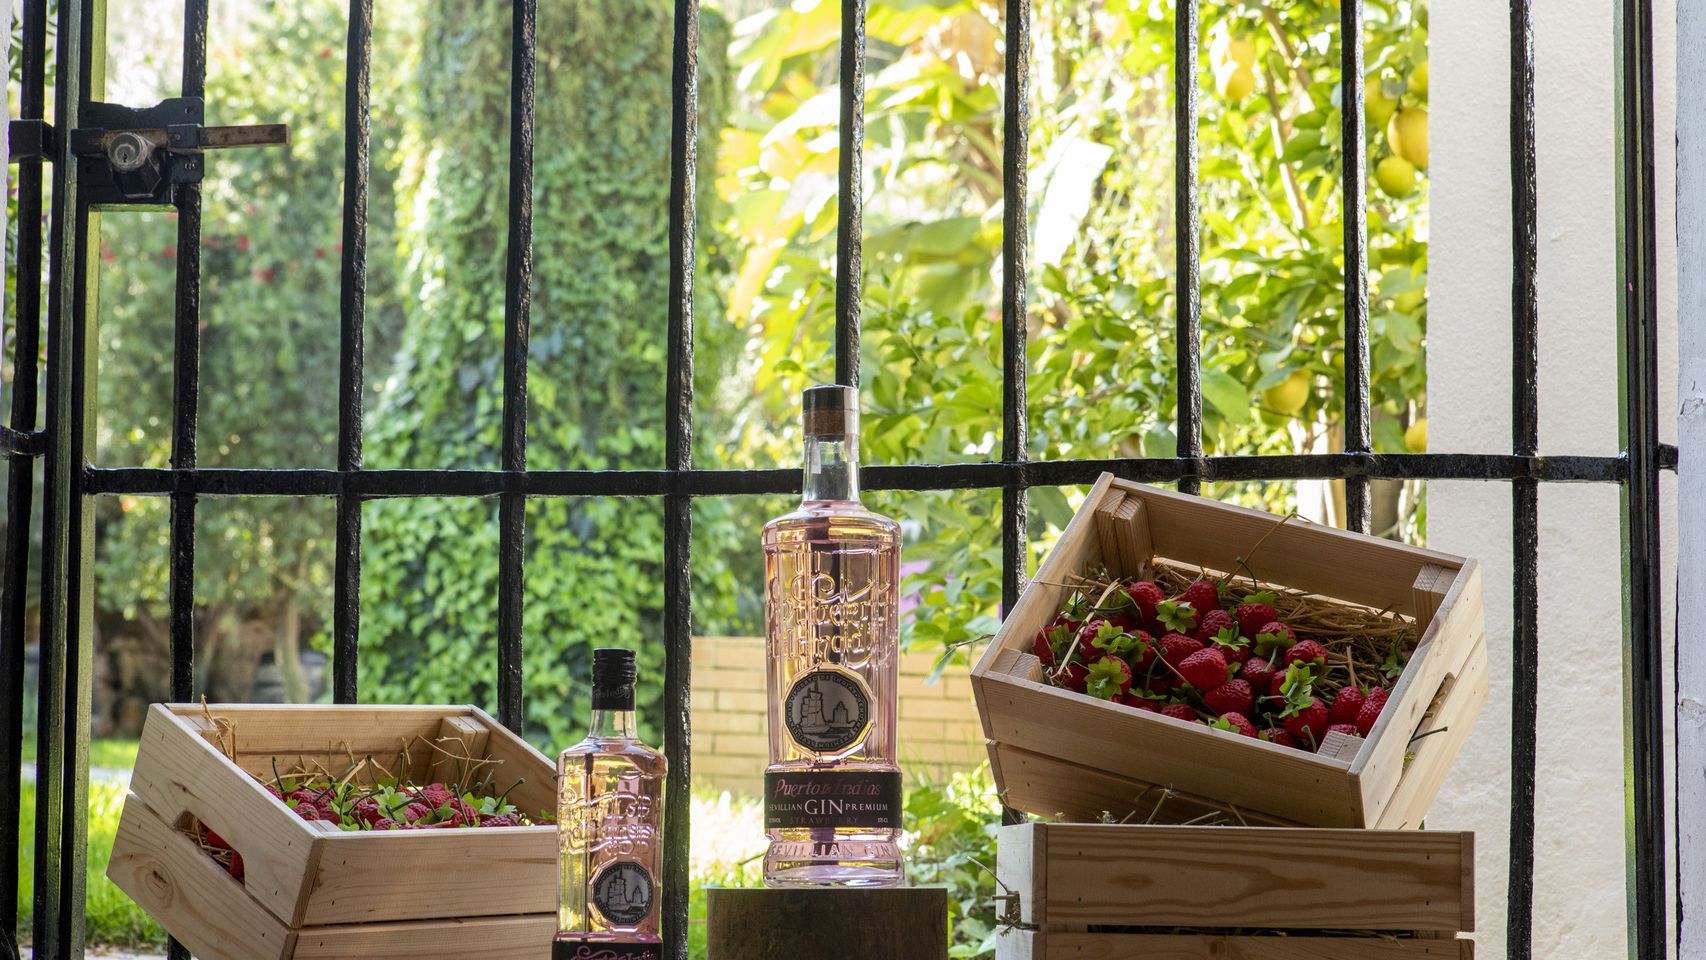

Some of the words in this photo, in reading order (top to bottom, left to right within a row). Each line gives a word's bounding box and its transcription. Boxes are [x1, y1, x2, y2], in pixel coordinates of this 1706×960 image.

[775, 778, 820, 799] Puerto
[831, 779, 881, 796] Indias
[768, 803, 803, 811] SEVILLIAN
[804, 799, 844, 815] GIN
[845, 803, 888, 811] PREMIUM
